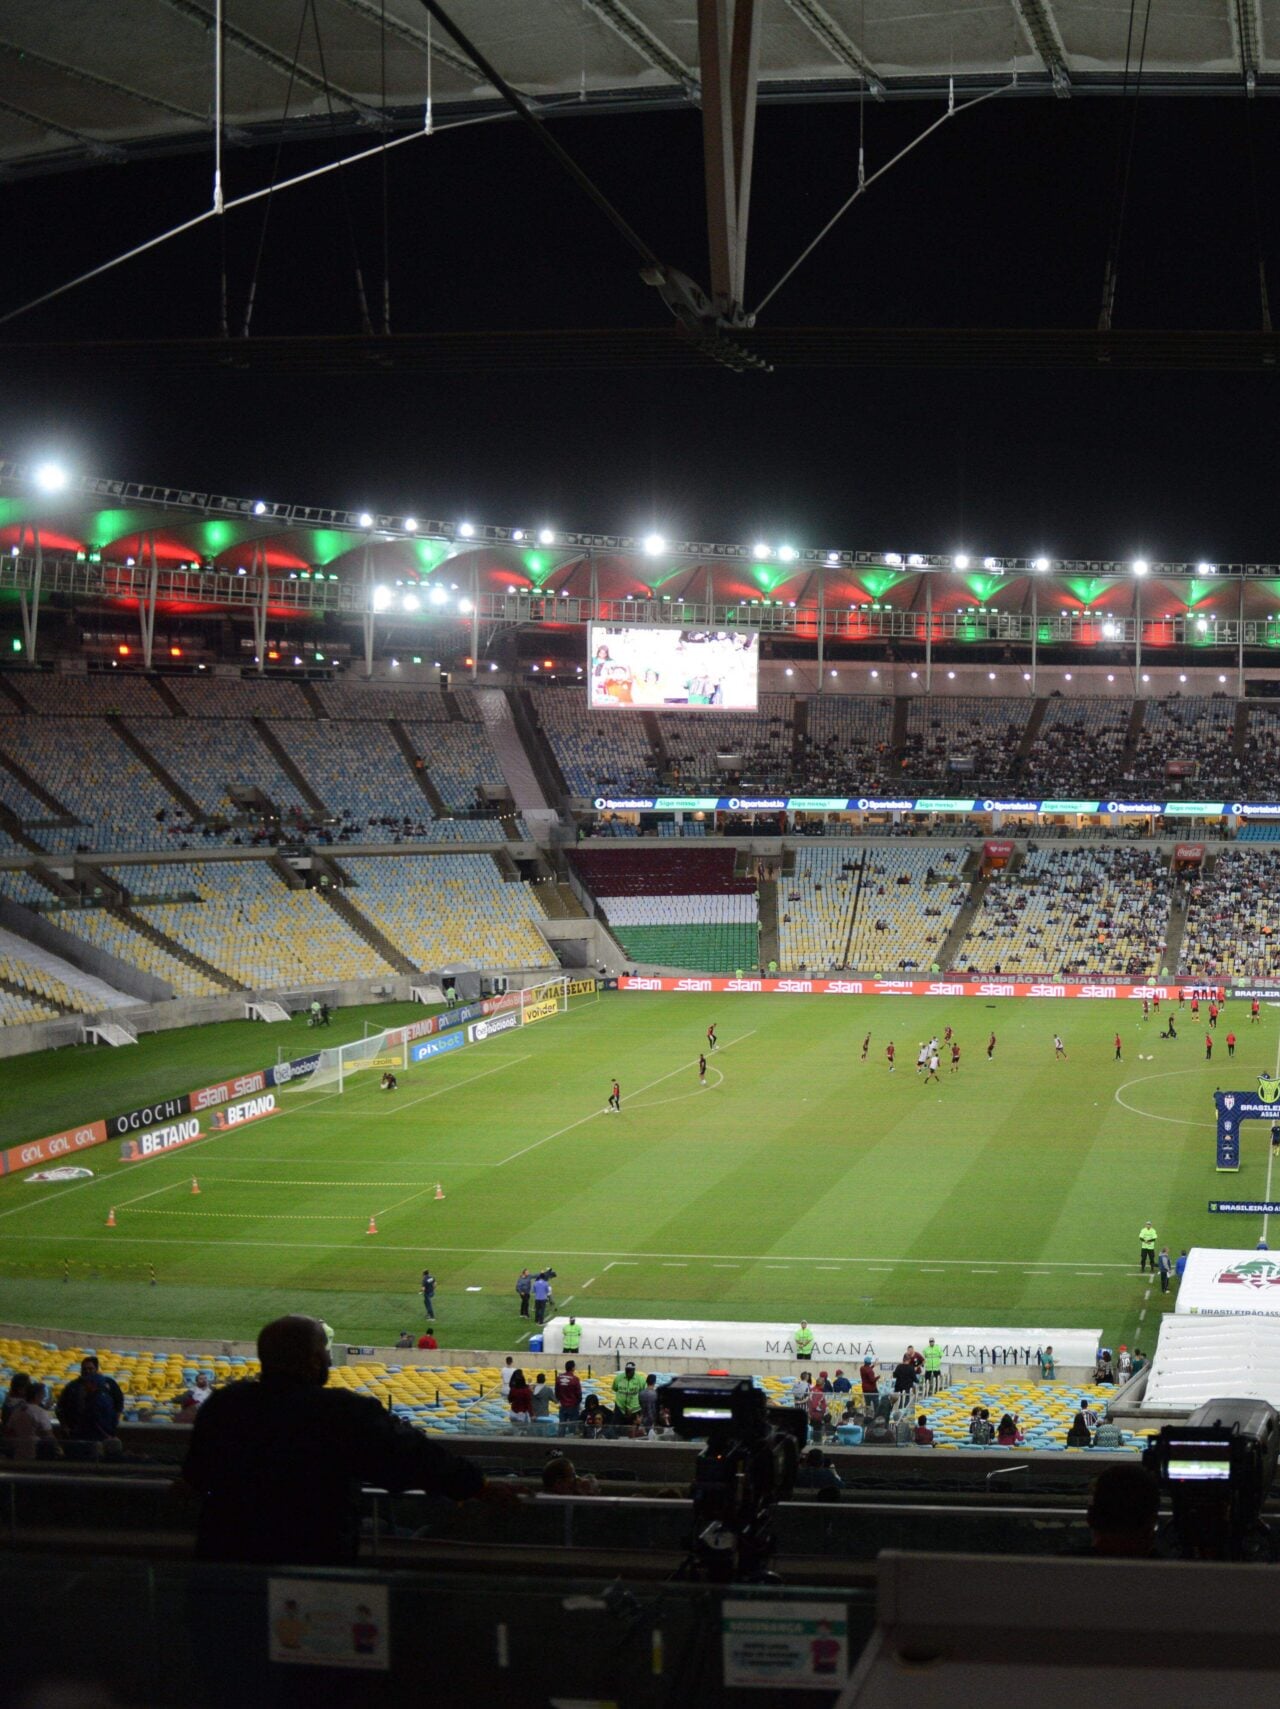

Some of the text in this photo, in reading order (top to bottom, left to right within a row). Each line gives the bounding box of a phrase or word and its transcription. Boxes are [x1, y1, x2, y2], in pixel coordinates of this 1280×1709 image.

[624, 977, 661, 990] stam
[673, 978, 711, 991] stam
[723, 979, 762, 991] stam
[773, 979, 812, 992] stam
[972, 975, 1034, 984] CAMPEÃO
[534, 980, 592, 999] UNIASSELVI
[824, 980, 863, 993] stam
[924, 982, 963, 995] stam
[975, 983, 1014, 996] stam
[1026, 984, 1065, 996] stam
[1077, 985, 1116, 998] stam
[1128, 985, 1167, 998] stam
[526, 1003, 555, 1020] vonder
[419, 1034, 460, 1060] pixbet
[231, 1074, 264, 1098] stam
[117, 1099, 182, 1132] OGOCHI
[228, 1094, 275, 1125] BETANO
[142, 1118, 200, 1155] BETANO
[21, 1128, 96, 1163] GOL GOL GOL
[1219, 1204, 1274, 1212] BRASILEIRÃO
[598, 1335, 706, 1351] MARACANÃ
[765, 1340, 876, 1356] MAACANÃ
